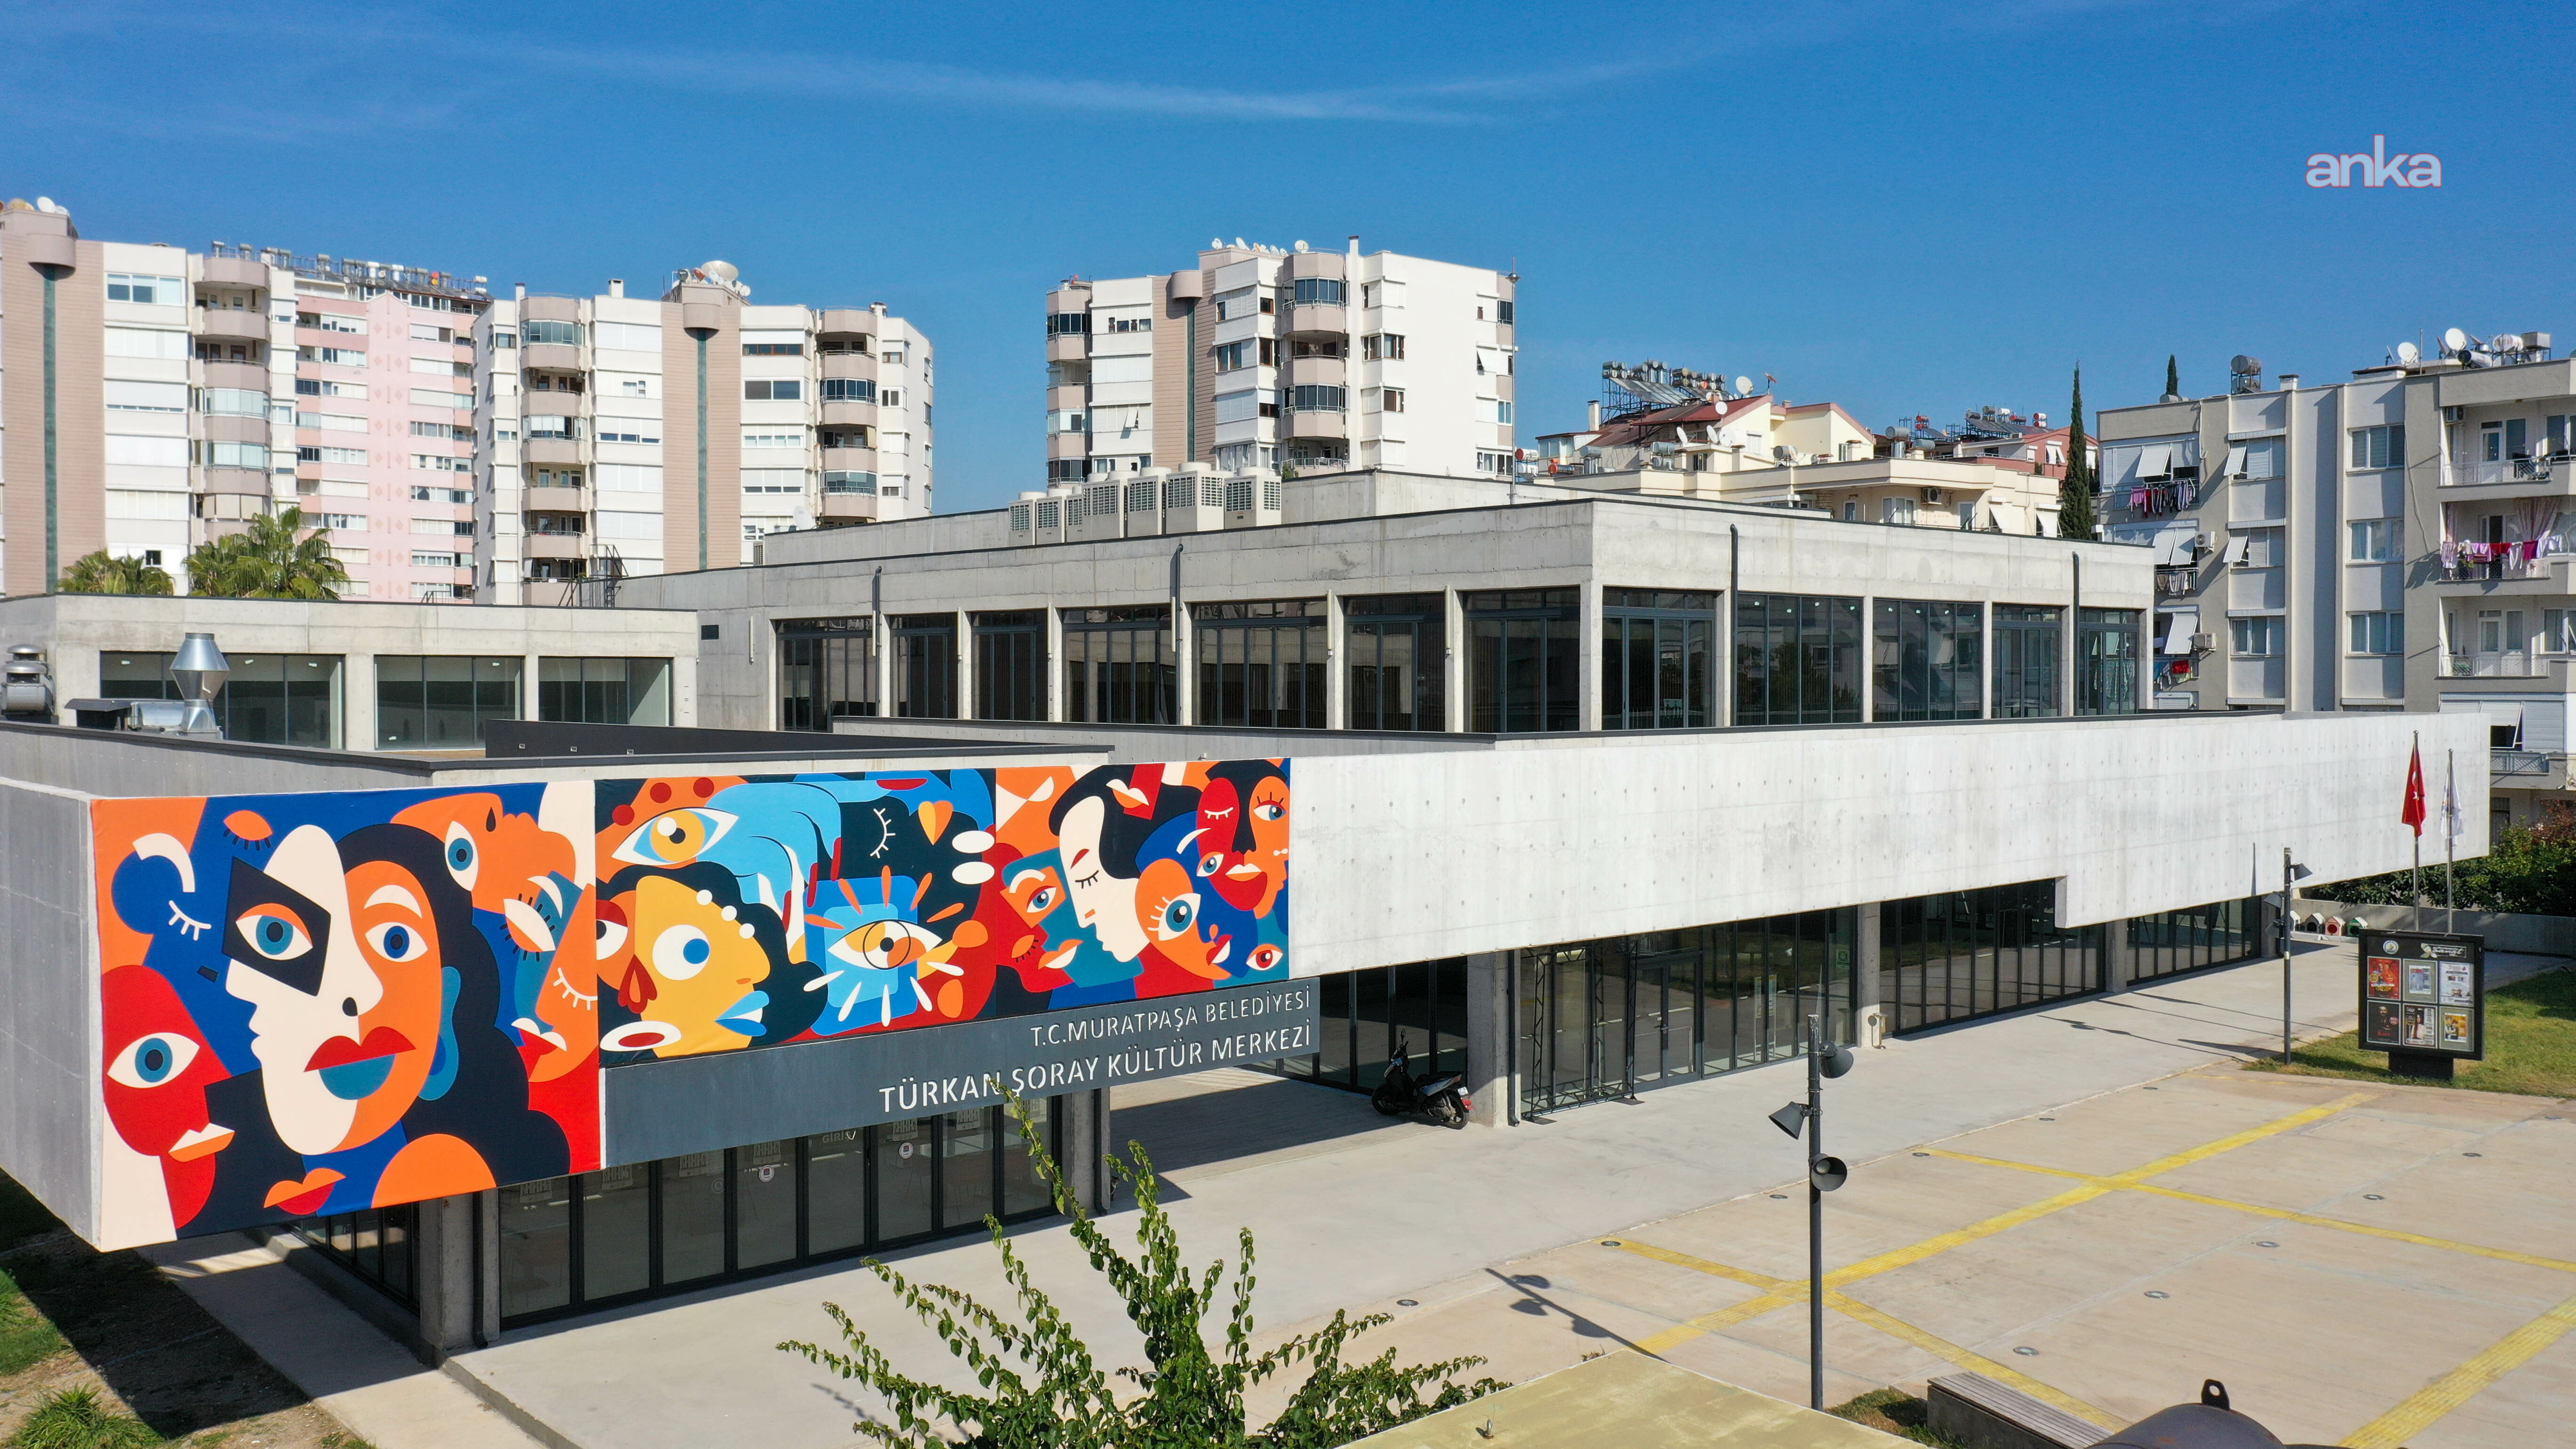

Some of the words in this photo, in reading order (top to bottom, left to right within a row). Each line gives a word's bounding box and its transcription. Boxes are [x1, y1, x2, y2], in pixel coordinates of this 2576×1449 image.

[1205, 985, 1310, 1022] BELEDİYESİ
[878, 1071, 1000, 1113] TÜRKAN
[1011, 1057, 1099, 1098] ŞORAY
[1107, 1039, 1203, 1079] KÜLTÜR
[1211, 1019, 1310, 1061] MERKEZİ
